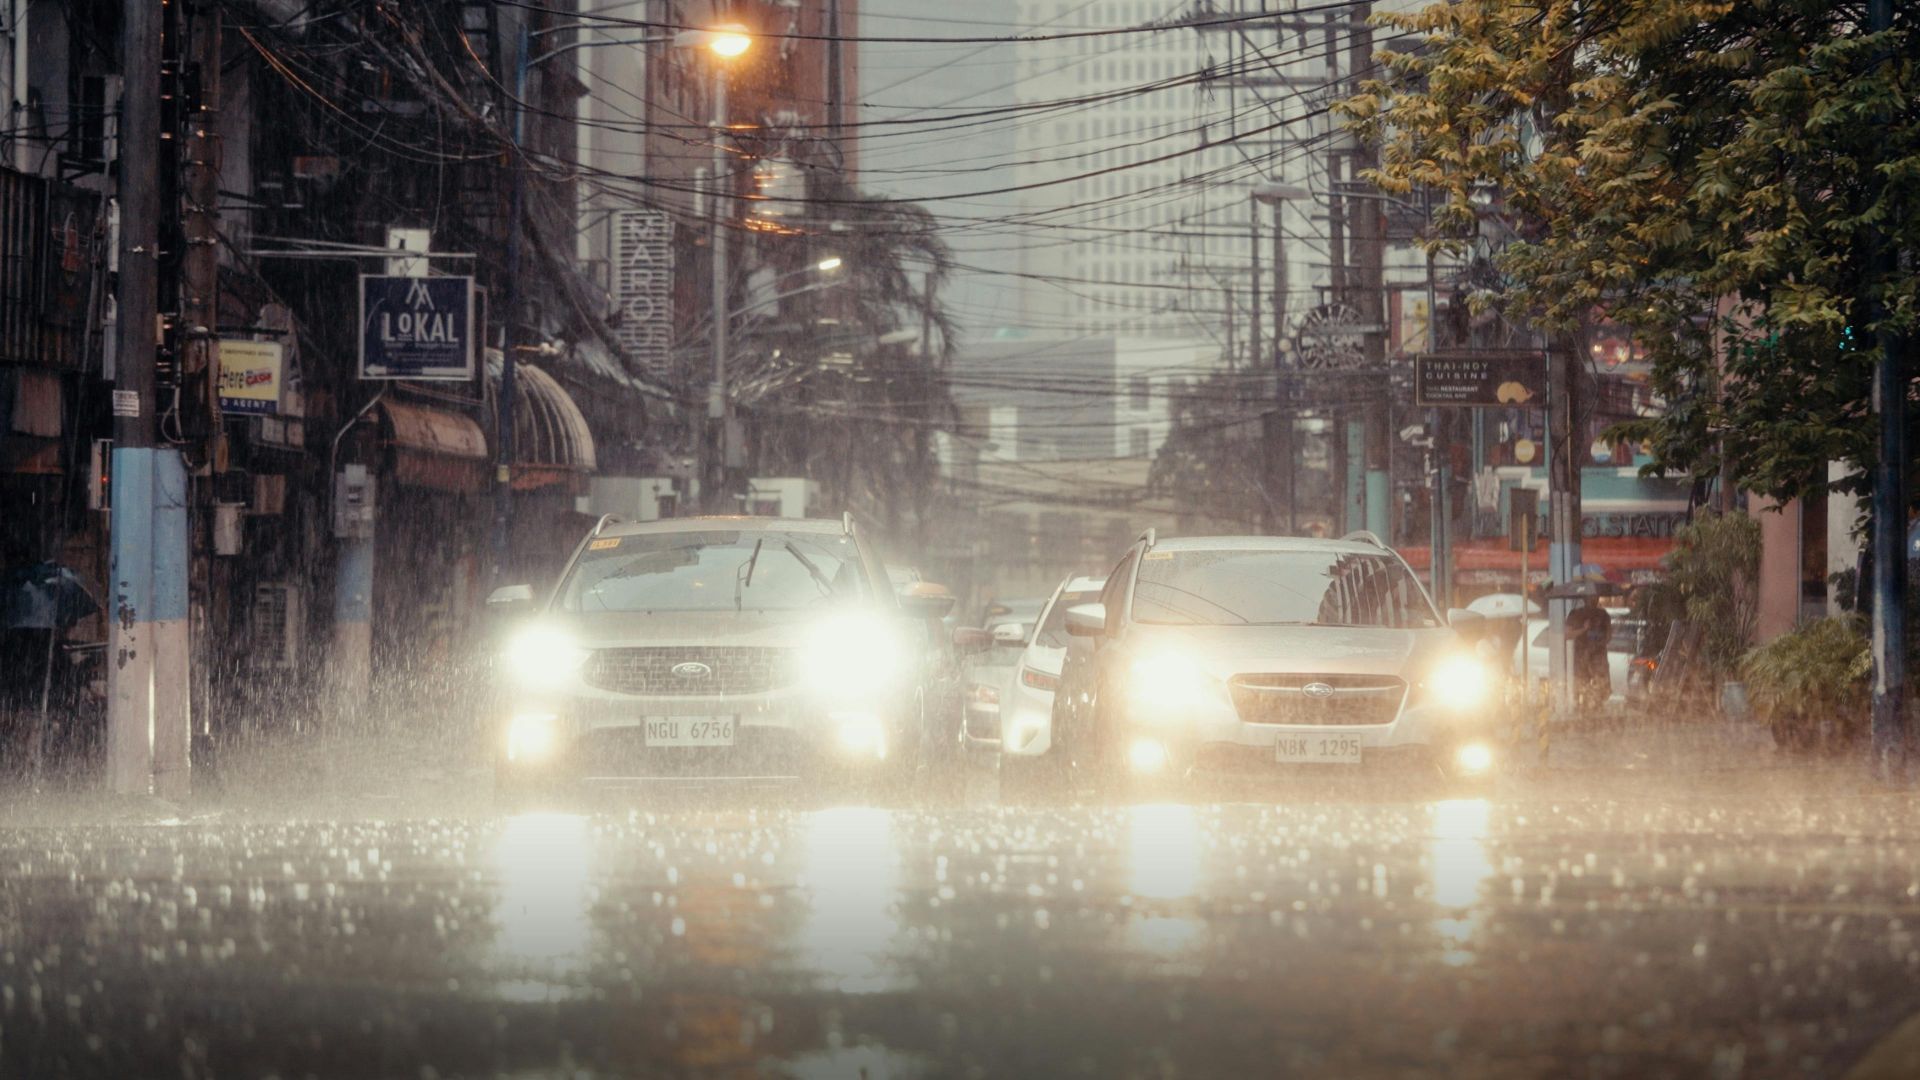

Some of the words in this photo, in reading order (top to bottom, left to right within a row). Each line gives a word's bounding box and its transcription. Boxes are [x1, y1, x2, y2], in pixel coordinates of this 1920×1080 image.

[1426, 361, 1489, 371] THAI-NOY
[1426, 371, 1488, 380] CUISINE
[233, 399, 266, 408] AGENT
[1604, 513, 1690, 537] STATIO
[647, 722, 678, 739] NGU
[690, 722, 732, 739] 6756
[1278, 739, 1308, 756] NBK
[1319, 739, 1359, 756] 1295
